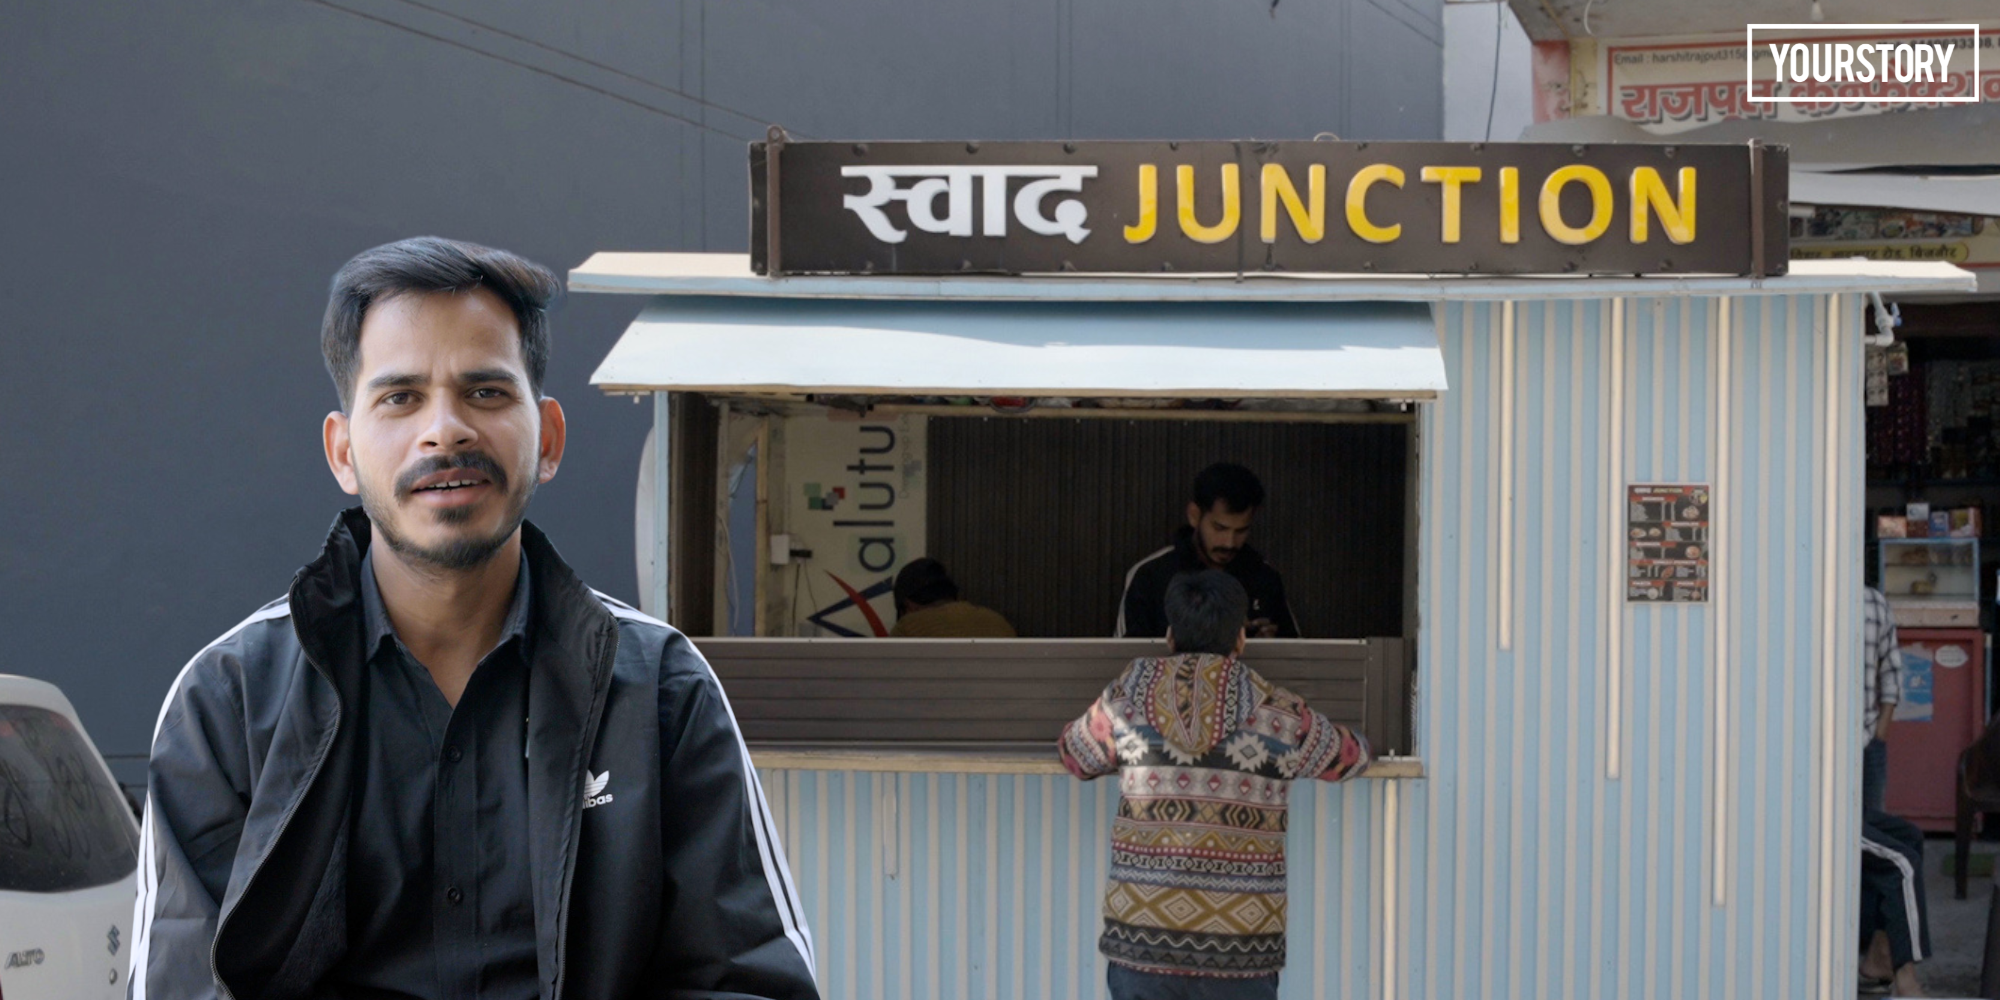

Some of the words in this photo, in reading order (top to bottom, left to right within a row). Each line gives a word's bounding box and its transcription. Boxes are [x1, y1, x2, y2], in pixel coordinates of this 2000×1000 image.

[1614, 53, 1644, 65] Email
[841, 165, 1098, 244] स्वाद
[1124, 163, 1696, 245] JUNCTION
[583, 794, 613, 809] ibas
[4, 948, 45, 970] ALTO
